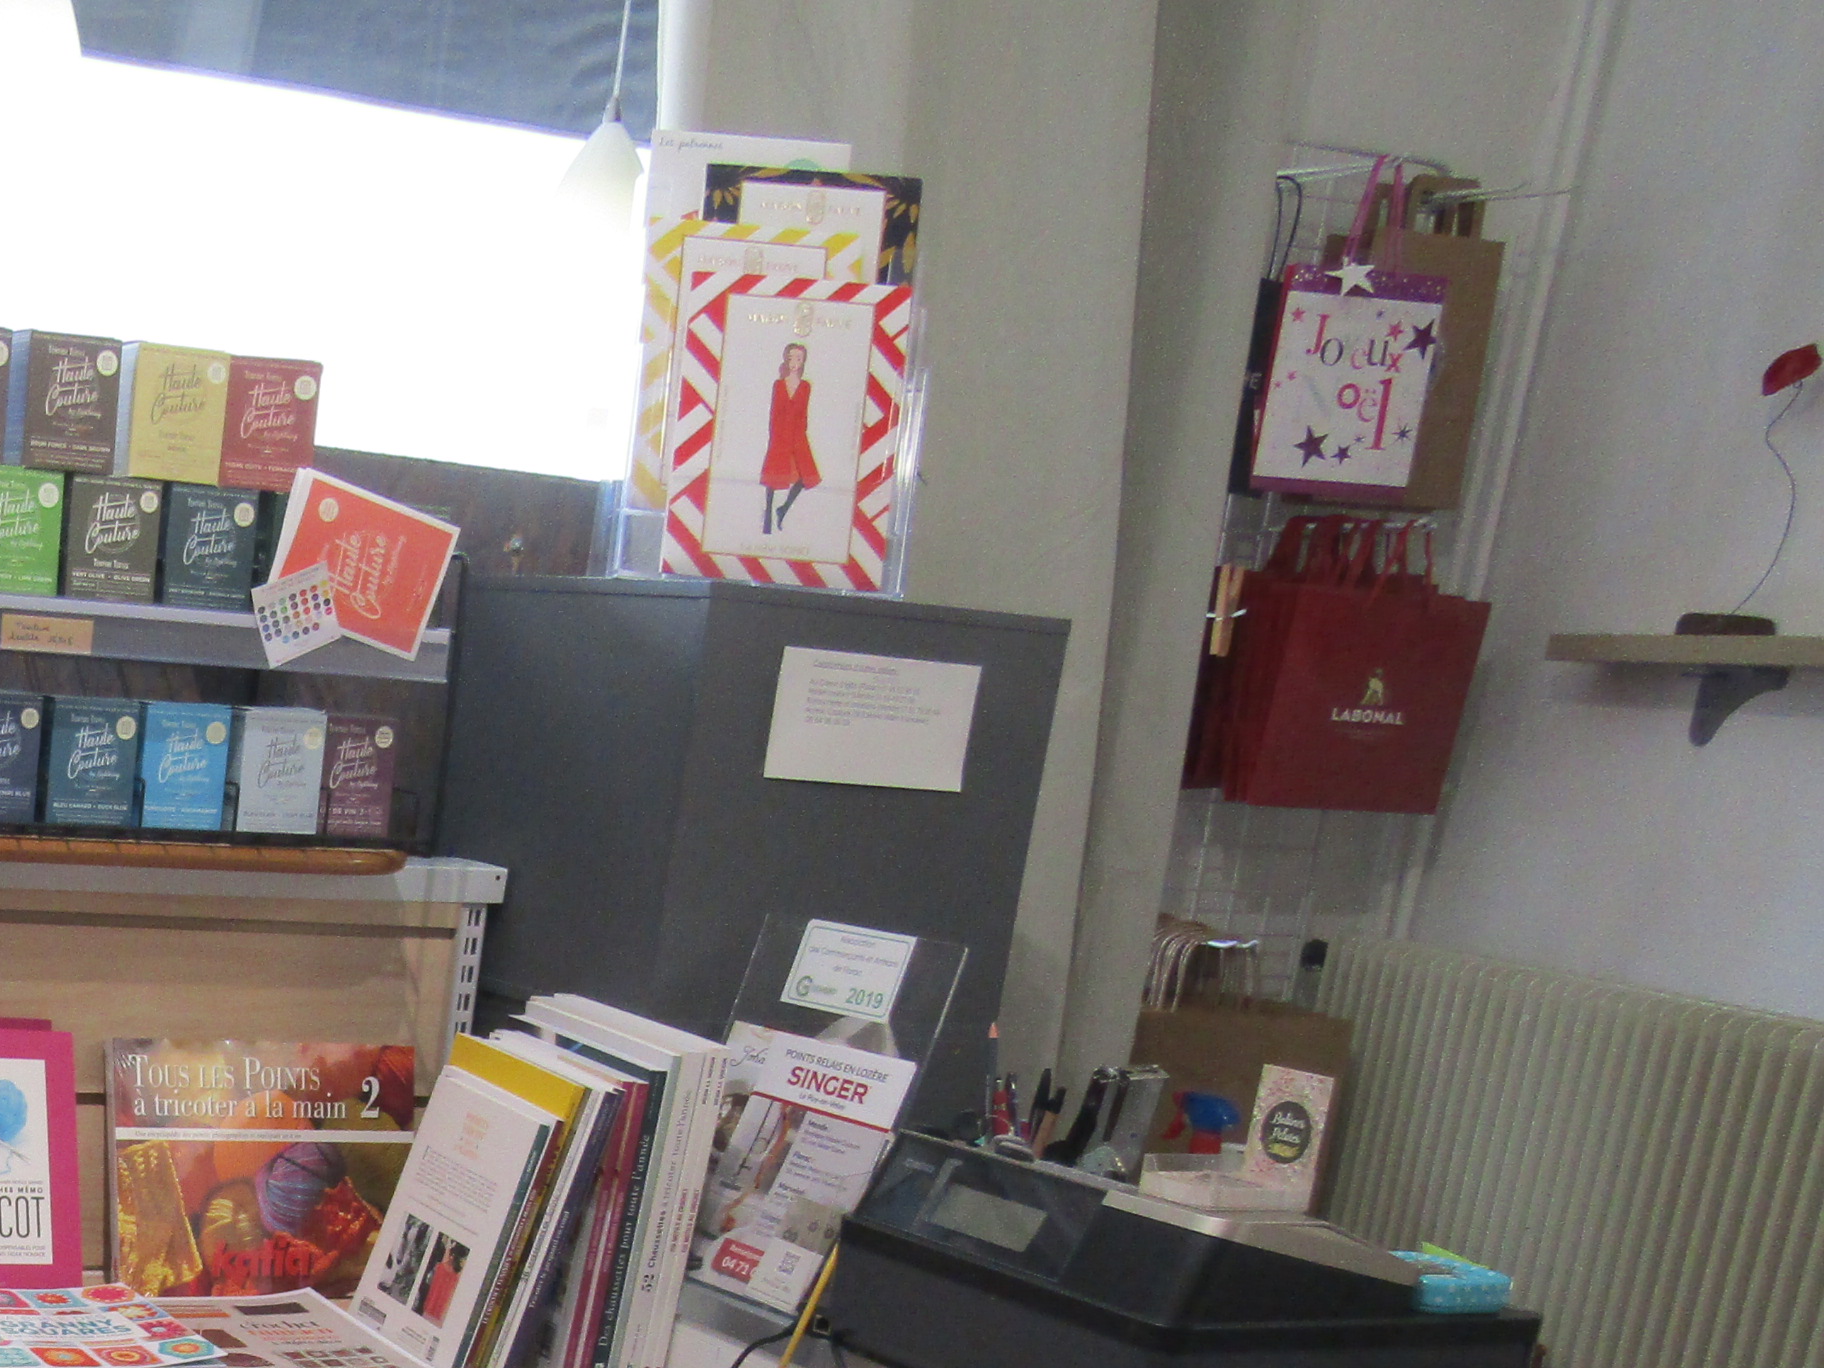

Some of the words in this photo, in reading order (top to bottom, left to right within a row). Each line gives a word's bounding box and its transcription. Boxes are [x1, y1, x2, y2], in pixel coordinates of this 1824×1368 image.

[52, 356, 96, 383] Haute
[45, 383, 99, 416] Couture
[248, 381, 294, 408] Haute
[240, 406, 296, 439] Couture
[92, 491, 136, 522] Haute
[191, 507, 232, 535] Haute
[85, 521, 140, 554] Couture
[182, 533, 235, 565] Couture
[1331, 707, 1405, 727] LABONAL
[75, 722, 114, 749] Haute
[166, 728, 203, 753] Haute
[337, 736, 374, 760] Haute
[67, 748, 118, 780] Couture
[158, 752, 208, 784] Couture
[329, 760, 378, 789] Couture
[845, 987, 884, 1009] 2019
[785, 1049, 816, 1065] POINTS
[815, 1056, 842, 1072] RELAIS
[843, 1064, 856, 1075] EN
[856, 1067, 889, 1083] LOZÈRE
[360, 1076, 381, 1119] 2
[787, 1065, 869, 1105] SINGER
[134, 1091, 145, 1117] à
[154, 1088, 237, 1118] tricoter
[244, 1090, 257, 1118] à
[265, 1090, 283, 1118] la
[293, 1092, 347, 1119] main
[630, 1133, 651, 1181] l'année
[18, 1185, 43, 1194] MÉMO
[626, 1184, 641, 1216] toute
[619, 1221, 634, 1249] pour
[645, 1209, 668, 1269] Chaussettes
[722, 1256, 735, 1270] 04
[737, 1262, 750, 1275] 71
[603, 1252, 627, 1321] chaussettes
[641, 1273, 654, 1293] 52
[0, 1317, 114, 1331] GRANNY
[3, 1324, 132, 1338] SQUARES
[598, 1324, 612, 1347] Des
